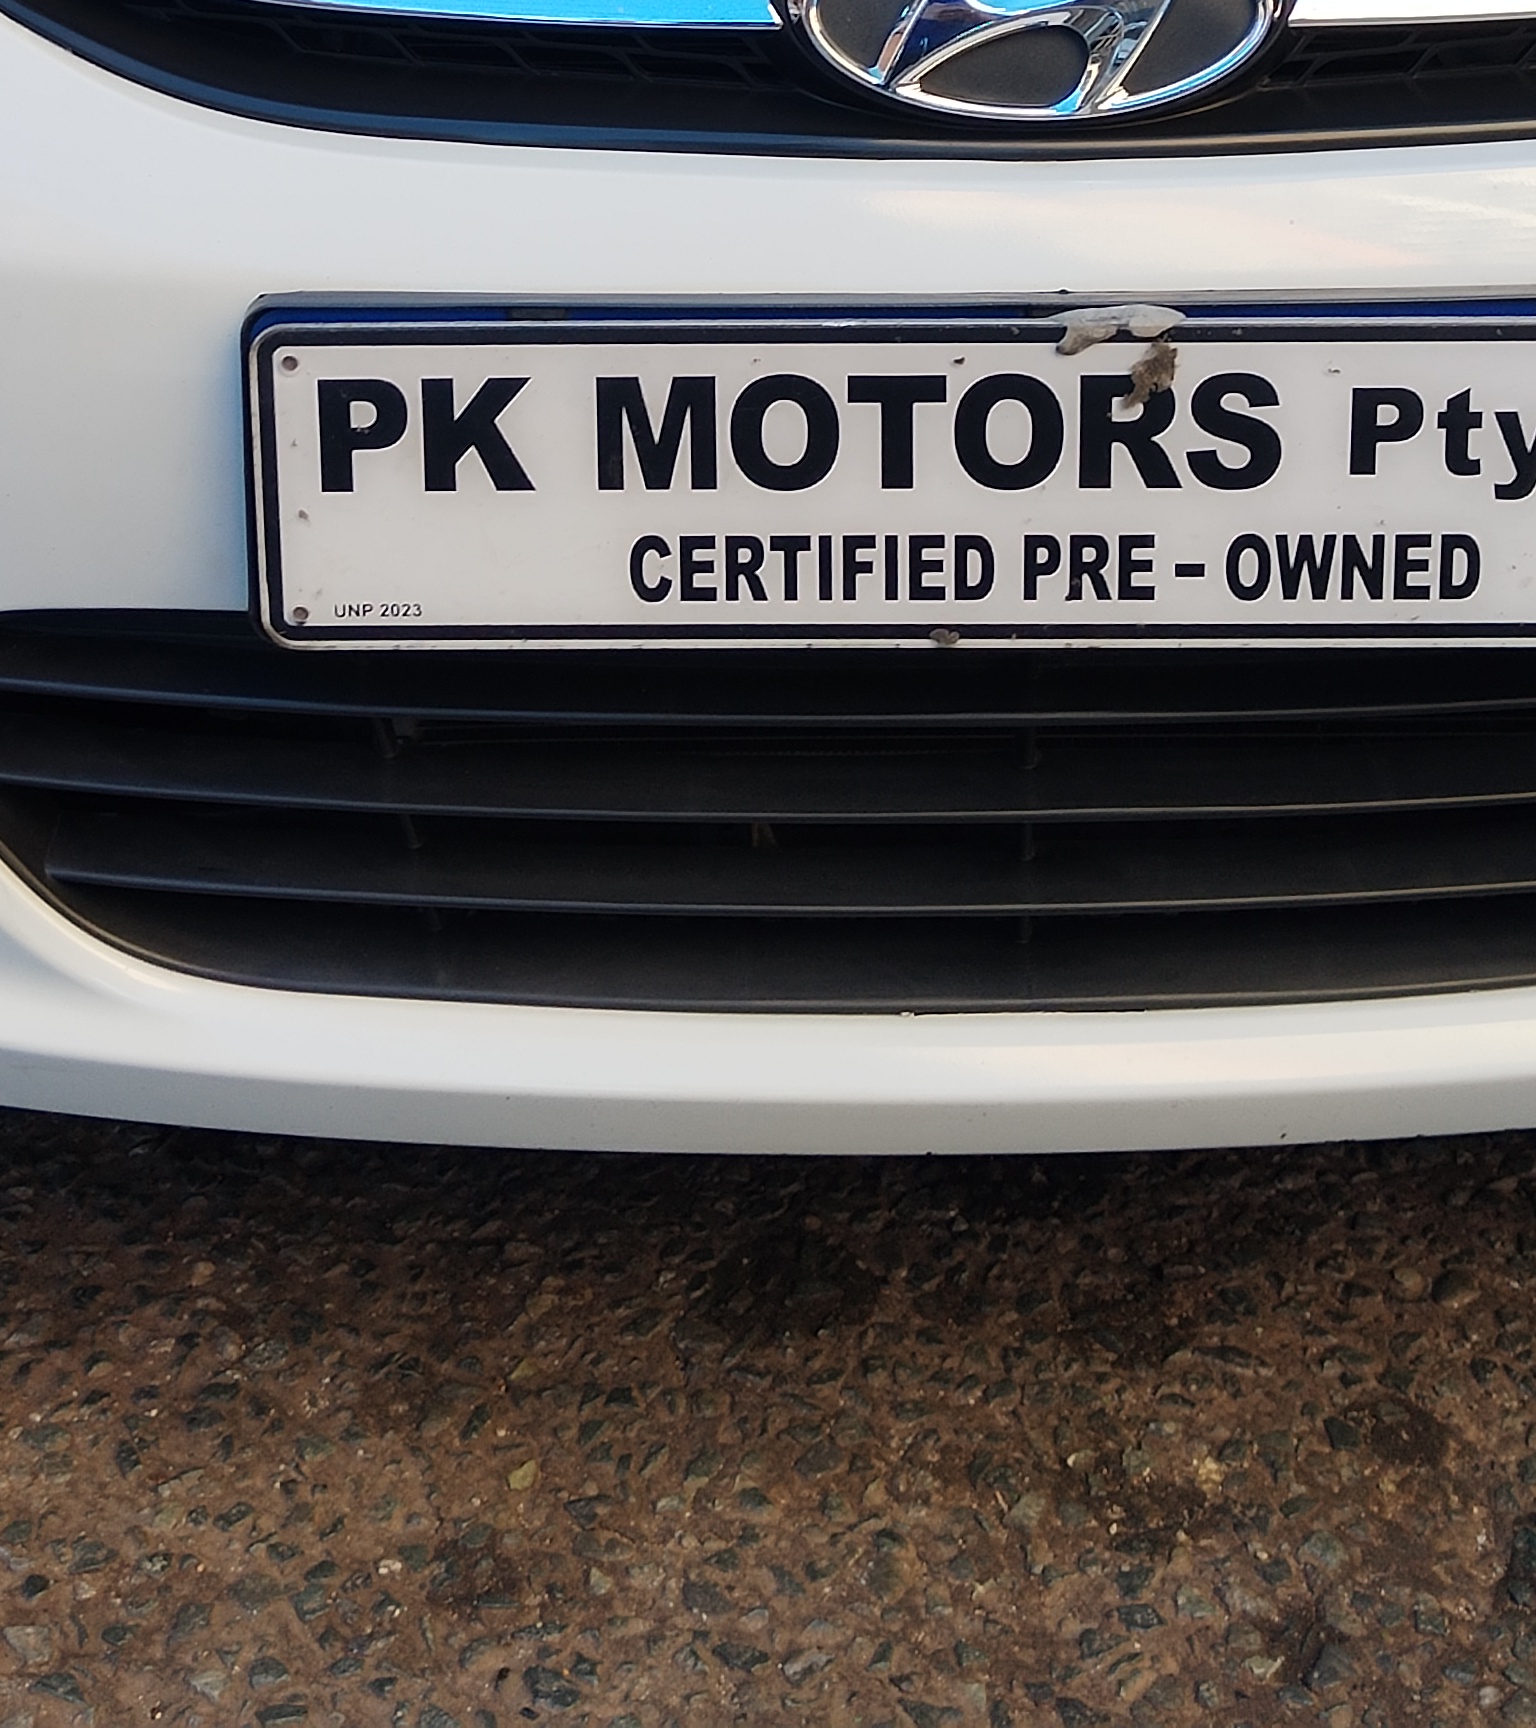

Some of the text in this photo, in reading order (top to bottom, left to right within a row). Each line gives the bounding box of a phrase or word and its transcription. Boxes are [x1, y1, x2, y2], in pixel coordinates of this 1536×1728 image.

[316, 376, 537, 494] PK
[594, 371, 1283, 493] MOTORS
[628, 533, 996, 604] CERTIFIED
[1022, 533, 1157, 603] PRE
[1224, 532, 1482, 603] OWNED
[333, 602, 423, 619] UNP 2023
